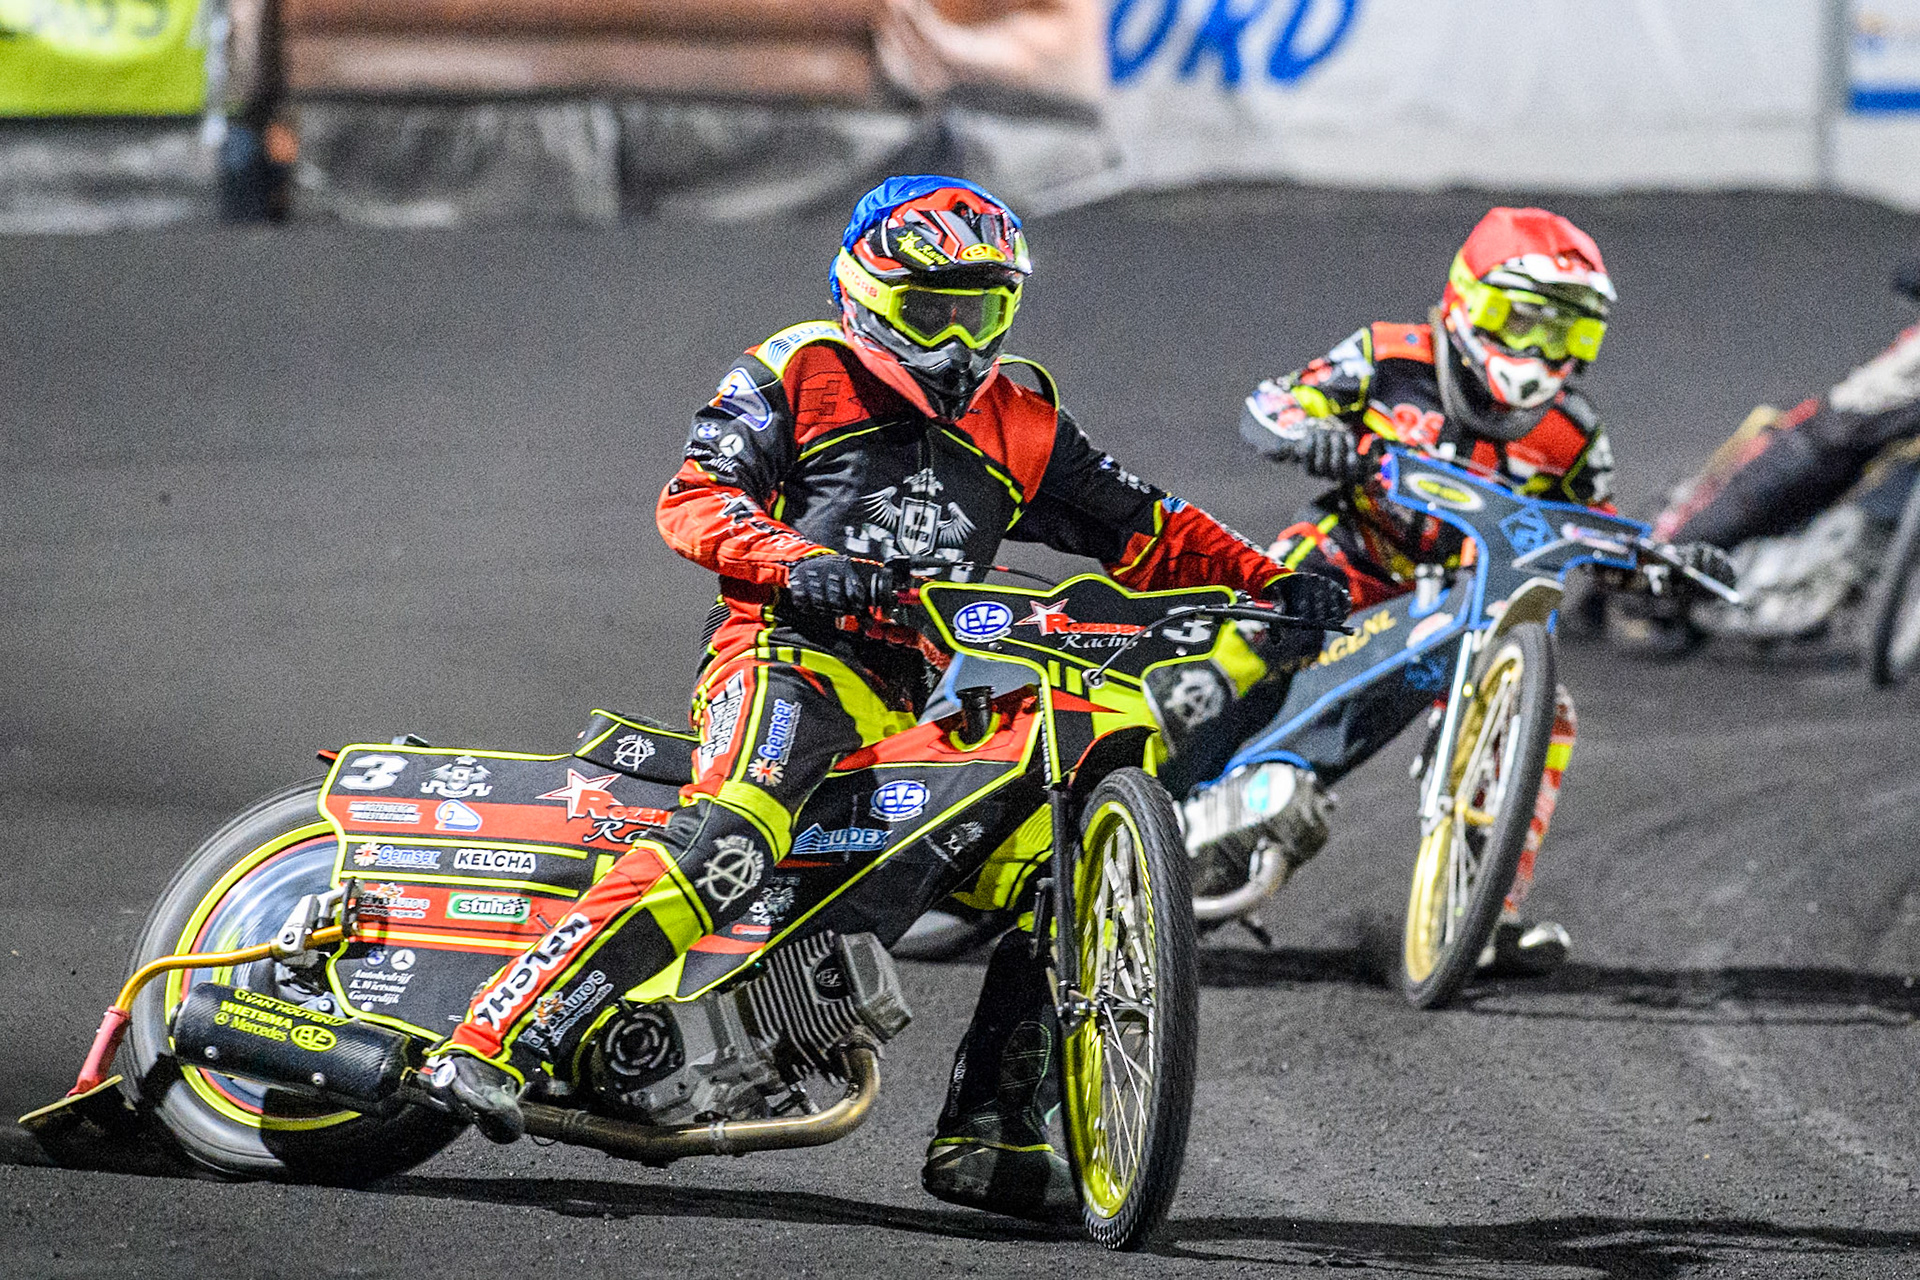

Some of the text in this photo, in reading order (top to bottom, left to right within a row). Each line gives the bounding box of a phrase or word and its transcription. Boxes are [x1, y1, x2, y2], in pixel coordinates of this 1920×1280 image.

[1057, 634, 1138, 650] Racing
[758, 699, 793, 760] Gemser
[339, 755, 409, 790] 3
[819, 829, 889, 844] BUDEX
[379, 845, 441, 864] Gemser
[457, 851, 533, 870] KELCHA
[351, 969, 415, 985] Autobedrijf
[220, 1000, 293, 1030] WIETSMA
[245, 995, 334, 1025] VAN HOUTEN
[230, 1015, 288, 1042] Mercedes
